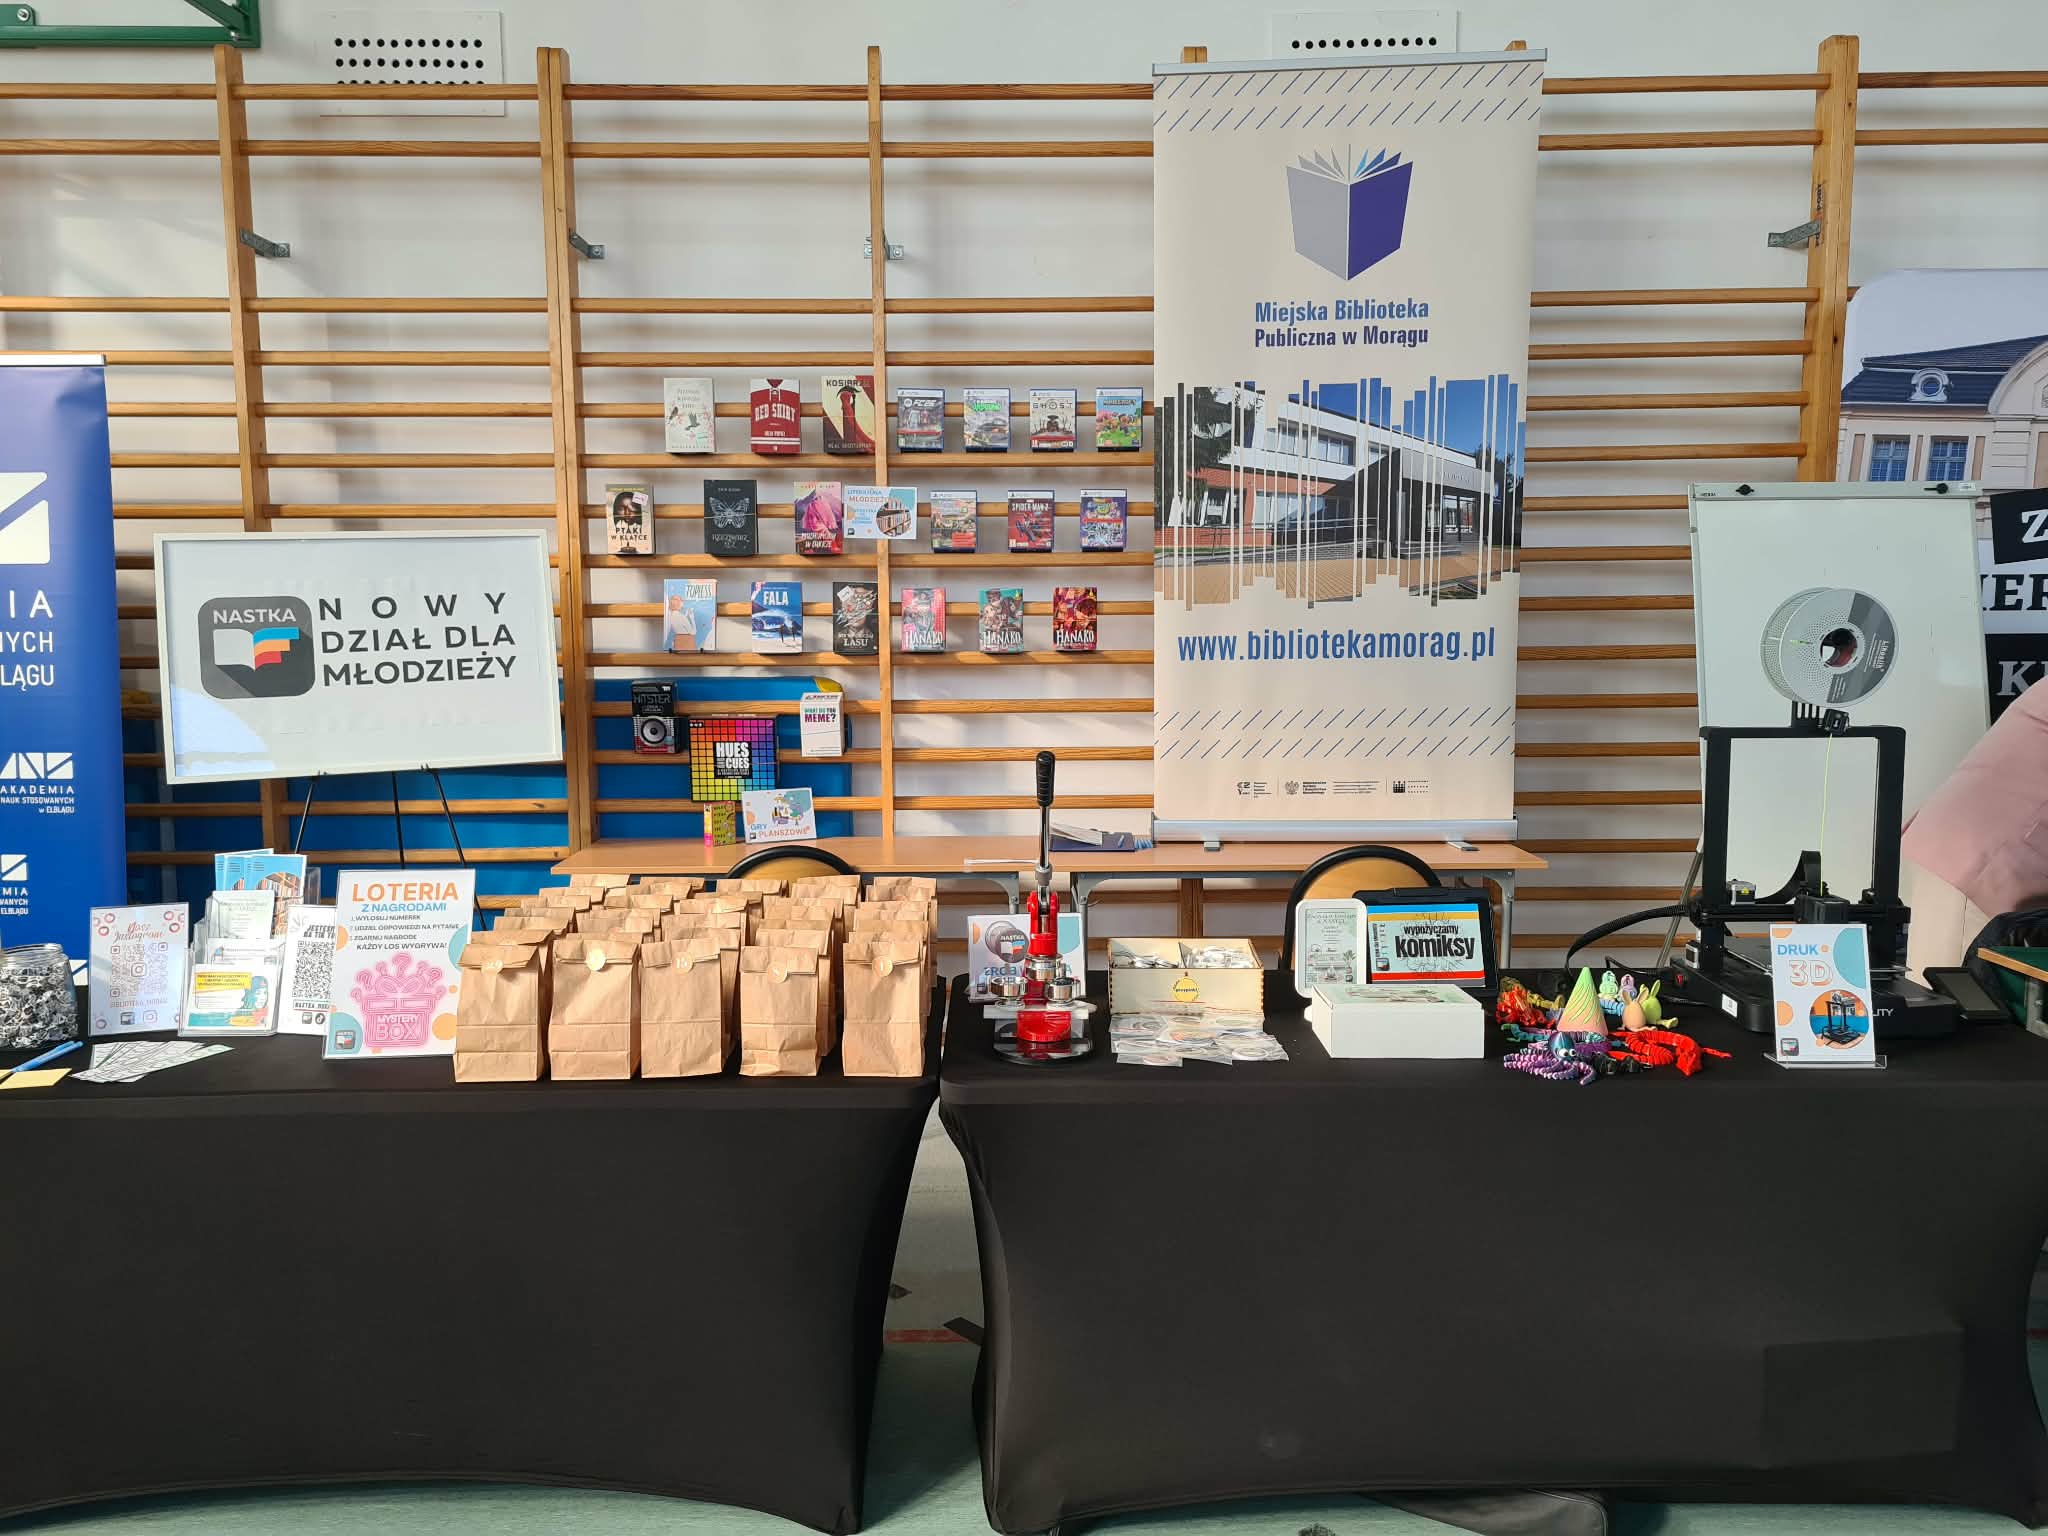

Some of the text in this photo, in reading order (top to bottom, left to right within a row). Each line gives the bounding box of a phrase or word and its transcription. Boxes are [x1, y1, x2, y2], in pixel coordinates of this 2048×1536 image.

[1255, 298, 1429, 326] Miejska Biblioteka
[1255, 326, 1428, 347] Publiczna w Morągu
[763, 591, 789, 606] FALA
[213, 608, 297, 625] NASTKA
[0, 631, 53, 653] YCH
[322, 624, 515, 654] DZIAŁ DLA
[843, 638, 869, 646] LASU
[1056, 629, 1094, 644] HANAKO
[1178, 627, 1495, 662] www.bibliotekamorag.pl
[323, 651, 516, 687] MŁODZIEŻY
[1997, 661, 2048, 695] K
[633, 693, 671, 704] HITSTER
[805, 713, 836, 722] MEME?
[716, 742, 750, 758] HUES
[726, 758, 750, 768] CUES
[0, 785, 74, 794] AKADEMIA
[759, 827, 808, 838] PLANSZOWE
[352, 883, 459, 902] LOTERIA
[362, 903, 447, 912] Z NAGRODAMI
[356, 942, 383, 950] KAŻDY
[1394, 934, 1475, 960] komiksy
[1777, 944, 1819, 956] DRUK
[1788, 960, 1834, 987] 3D
[377, 1014, 420, 1024] MYSTERY
[376, 1023, 418, 1041] BOX
